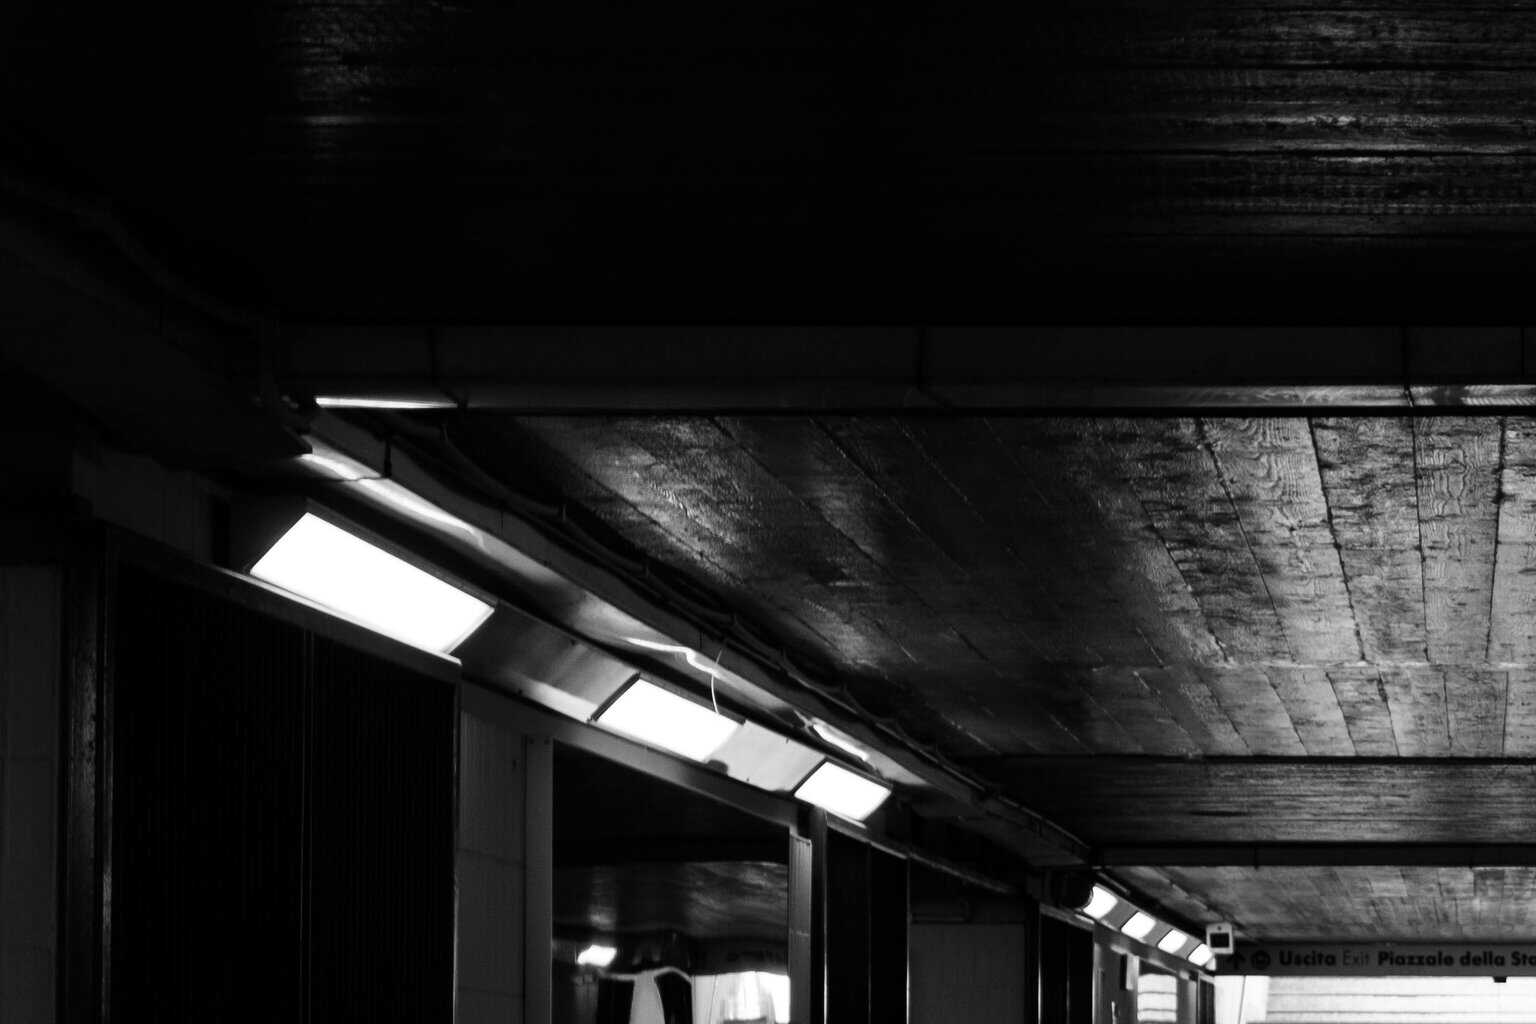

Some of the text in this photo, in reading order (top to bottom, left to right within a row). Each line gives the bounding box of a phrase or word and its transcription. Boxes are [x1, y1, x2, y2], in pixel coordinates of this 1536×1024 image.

[1279, 950, 1337, 967] Uscita
[1343, 951, 1370, 966] Exit
[1377, 950, 1455, 967] Piazzale
[1459, 950, 1505, 967] della
